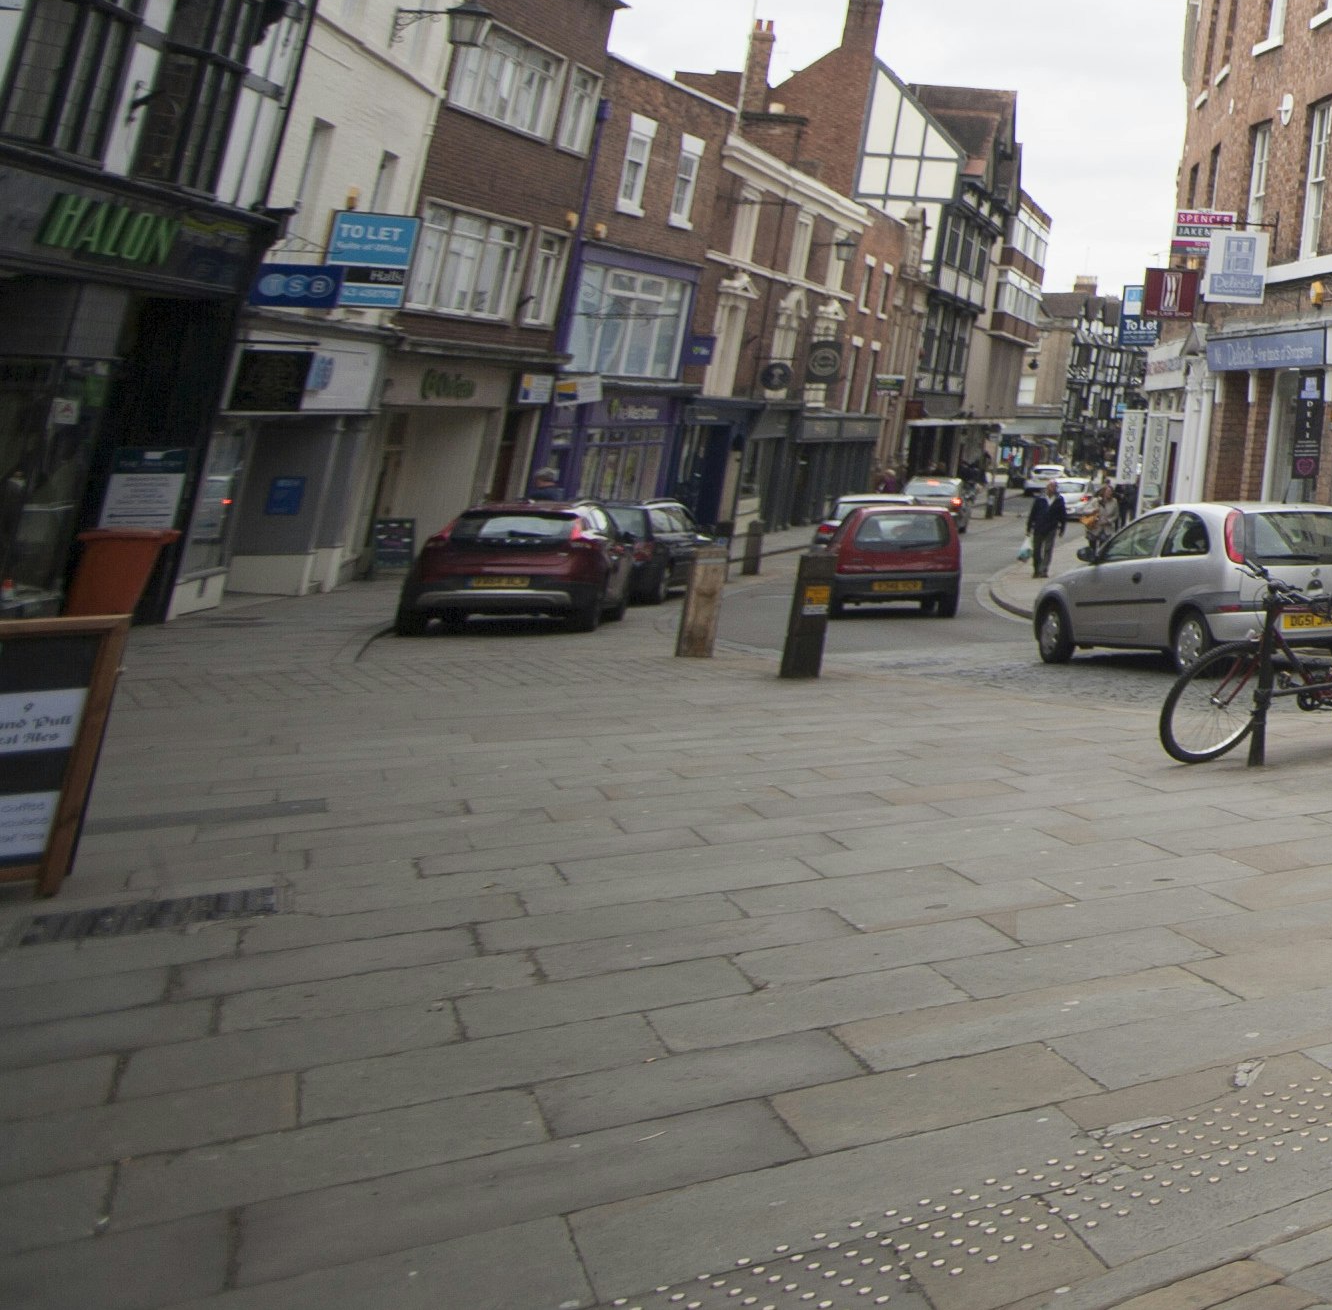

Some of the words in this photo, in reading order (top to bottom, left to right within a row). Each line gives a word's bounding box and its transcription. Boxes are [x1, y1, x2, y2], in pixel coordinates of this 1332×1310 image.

[1179, 213, 1231, 224] SPENCER
[44, 193, 182, 266] HALON
[340, 223, 364, 238] TO
[367, 226, 404, 241] LET
[1178, 227, 1211, 237] JAKEM
[1124, 319, 1138, 330] To
[1140, 319, 1158, 330] Let
